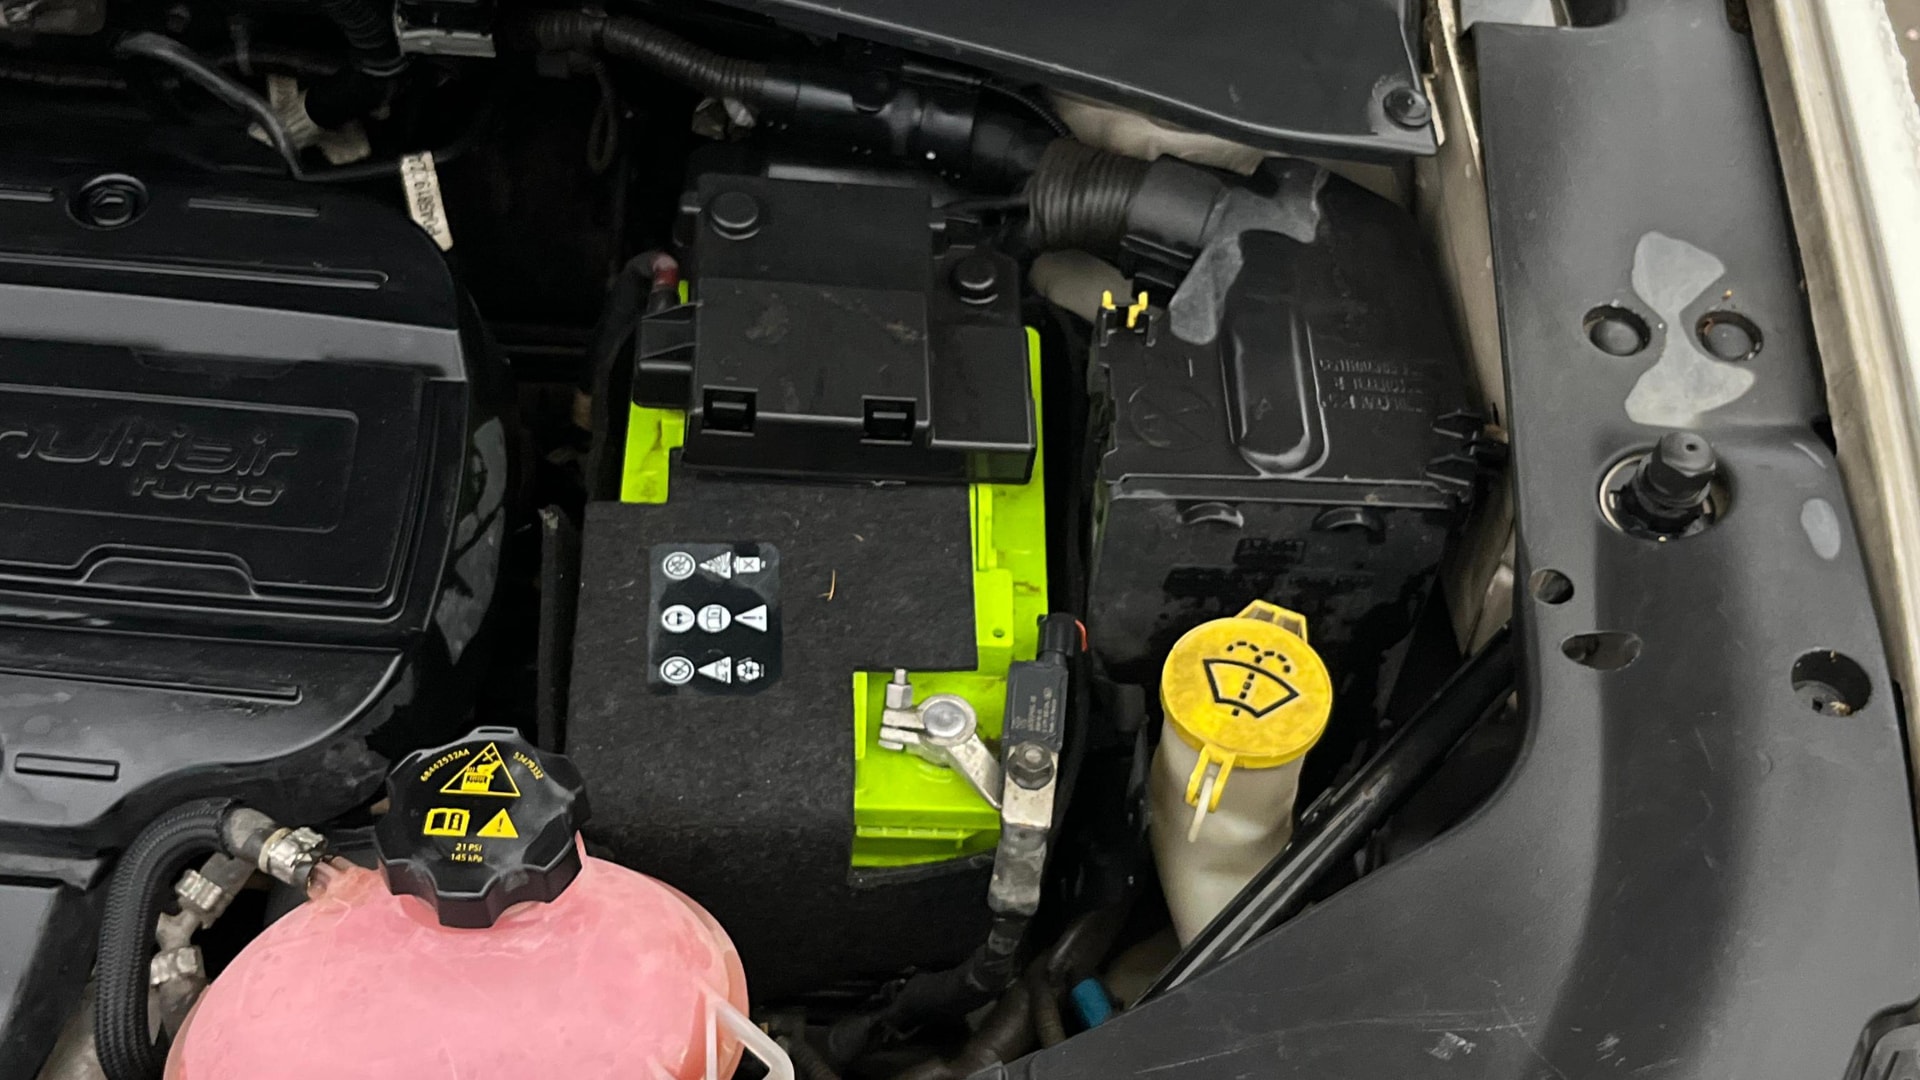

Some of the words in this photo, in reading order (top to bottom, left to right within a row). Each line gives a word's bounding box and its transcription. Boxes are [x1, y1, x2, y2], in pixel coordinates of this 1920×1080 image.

[455, 842, 467, 851] 21
[468, 843, 483, 852] PSI
[451, 853, 467, 862] 145
[468, 854, 483, 863] kPa
